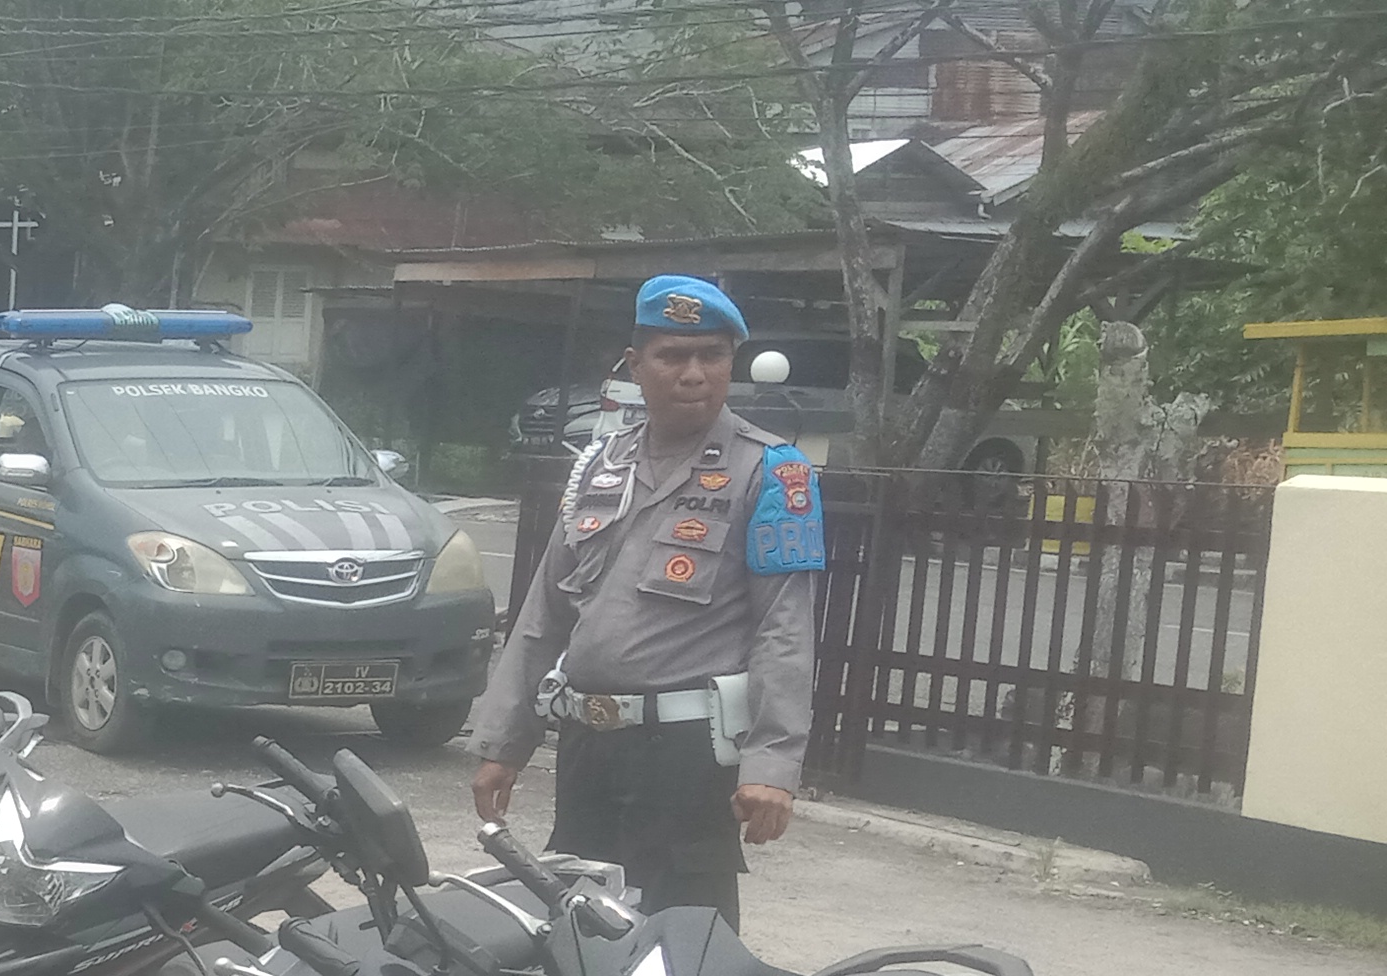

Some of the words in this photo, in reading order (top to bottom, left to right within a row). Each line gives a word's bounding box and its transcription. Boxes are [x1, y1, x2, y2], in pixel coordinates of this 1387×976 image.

[112, 383, 187, 397] POLSEK
[189, 384, 269, 398] BANGKO
[202, 499, 391, 518] POLISI
[356, 666, 370, 678] IV
[323, 681, 391, 694] 2102-34
